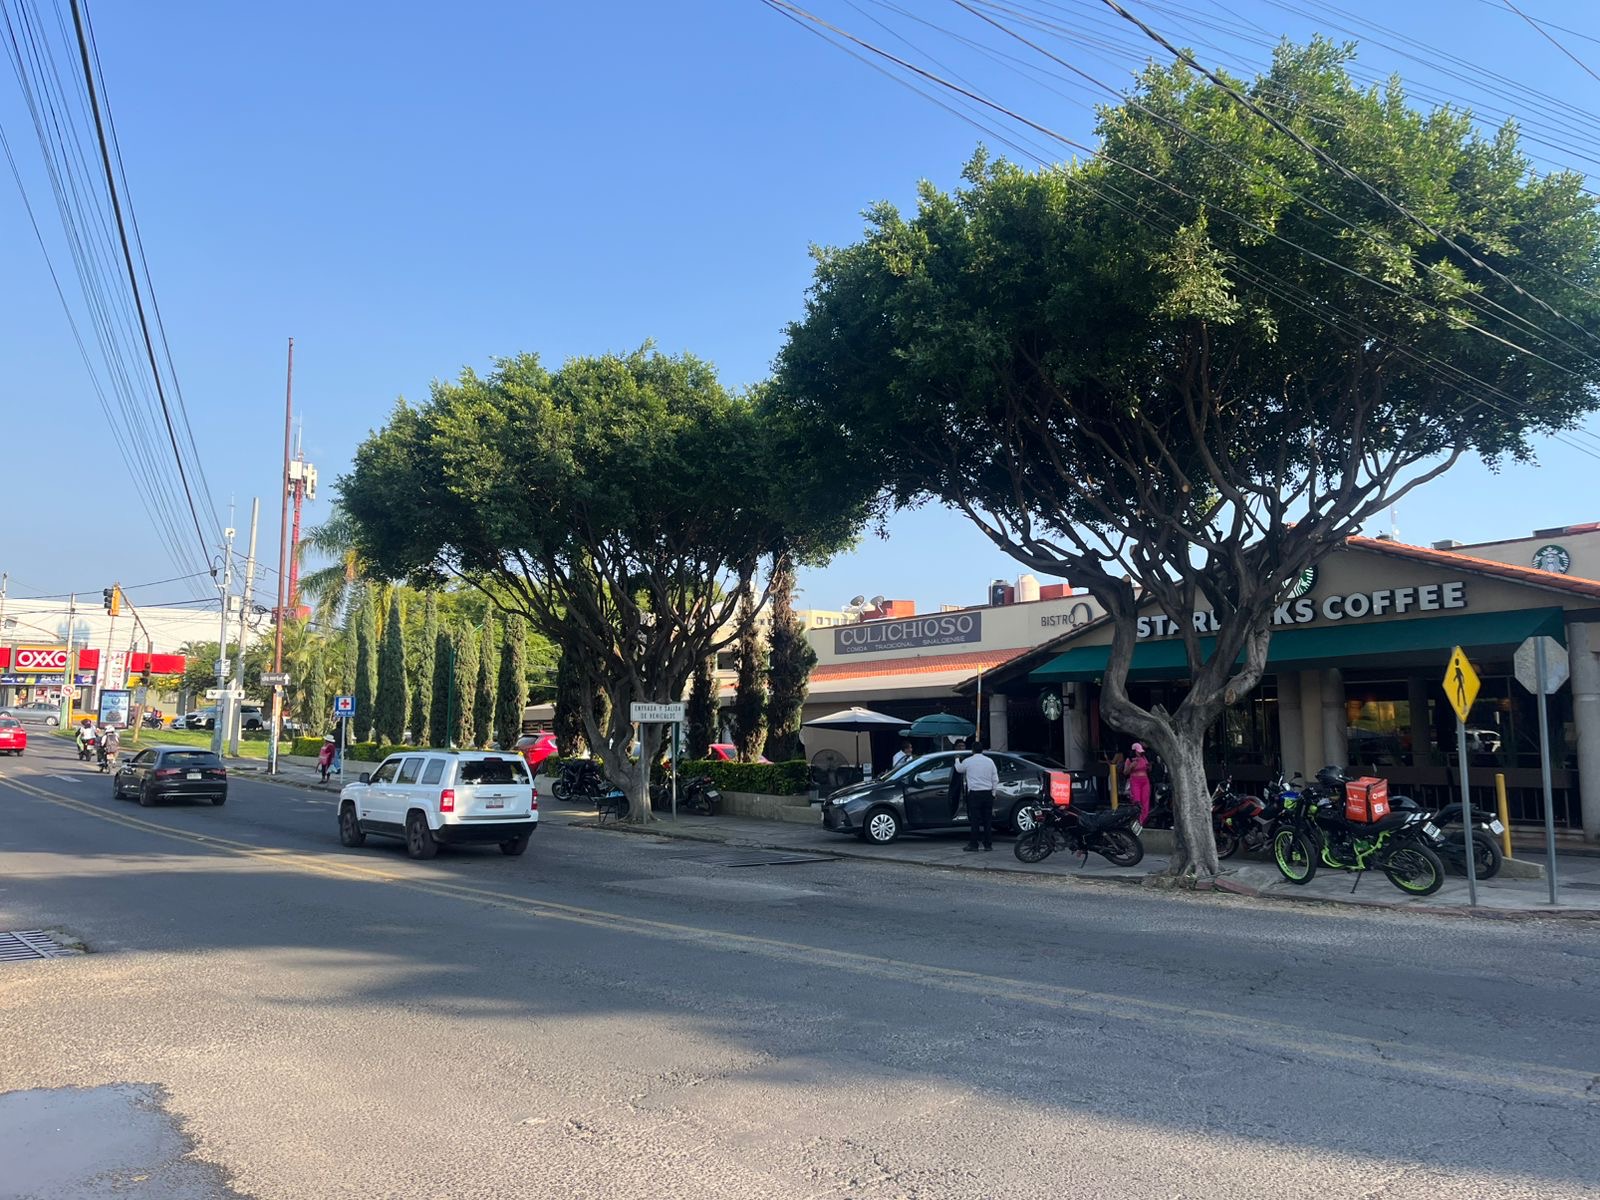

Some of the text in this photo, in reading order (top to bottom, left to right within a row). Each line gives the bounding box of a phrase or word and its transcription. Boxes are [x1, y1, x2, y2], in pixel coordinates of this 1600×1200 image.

[1040, 613, 1076, 627] BISTRO
[1136, 581, 1465, 638] STARKS COFFEE
[840, 615, 974, 646] CULICHIOSO
[846, 635, 966, 653] COMIDA TRADICIONAL SINALOENSE
